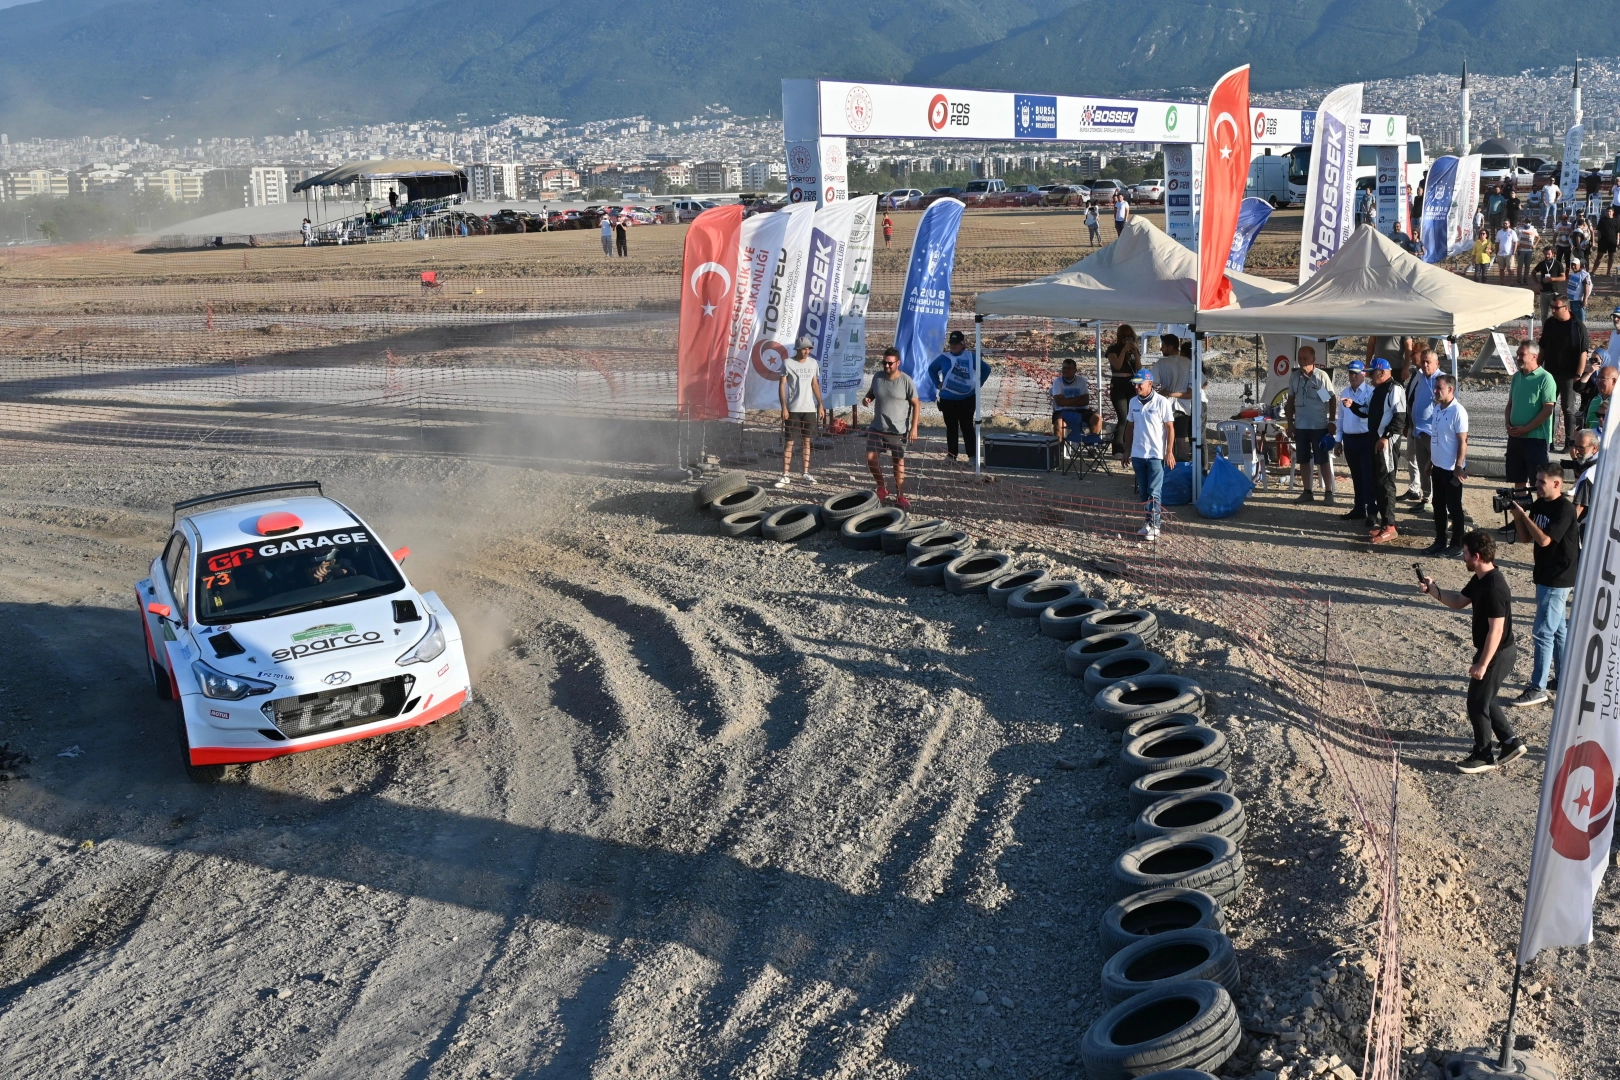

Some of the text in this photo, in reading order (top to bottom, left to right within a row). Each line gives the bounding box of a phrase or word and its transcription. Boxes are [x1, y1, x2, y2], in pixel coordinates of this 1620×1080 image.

[950, 115, 969, 126] FED
[951, 103, 970, 114] TOS
[1035, 106, 1055, 115] BURSA
[1094, 110, 1135, 124] BOSSEK
[1266, 118, 1277, 126] TOS
[1266, 126, 1276, 135] FED
[1346, 156, 1354, 181] SPOR
[1318, 122, 1343, 251] BOSSEK
[1344, 179, 1352, 223] SPORLARI
[836, 240, 846, 272] KULÜBÜ
[731, 266, 751, 323] GENÇLİK
[743, 246, 756, 263] VE
[833, 272, 842, 296] SPOR
[738, 249, 769, 351] SPOR BAKANLIĞI
[828, 295, 839, 332] SPORLARI
[258, 532, 368, 557] GARAGE
[202, 572, 231, 590] 73
[272, 631, 381, 660] sparco
[1600, 633, 1618, 720] TÜRKİYE
[211, 710, 229, 718] MOTUL
